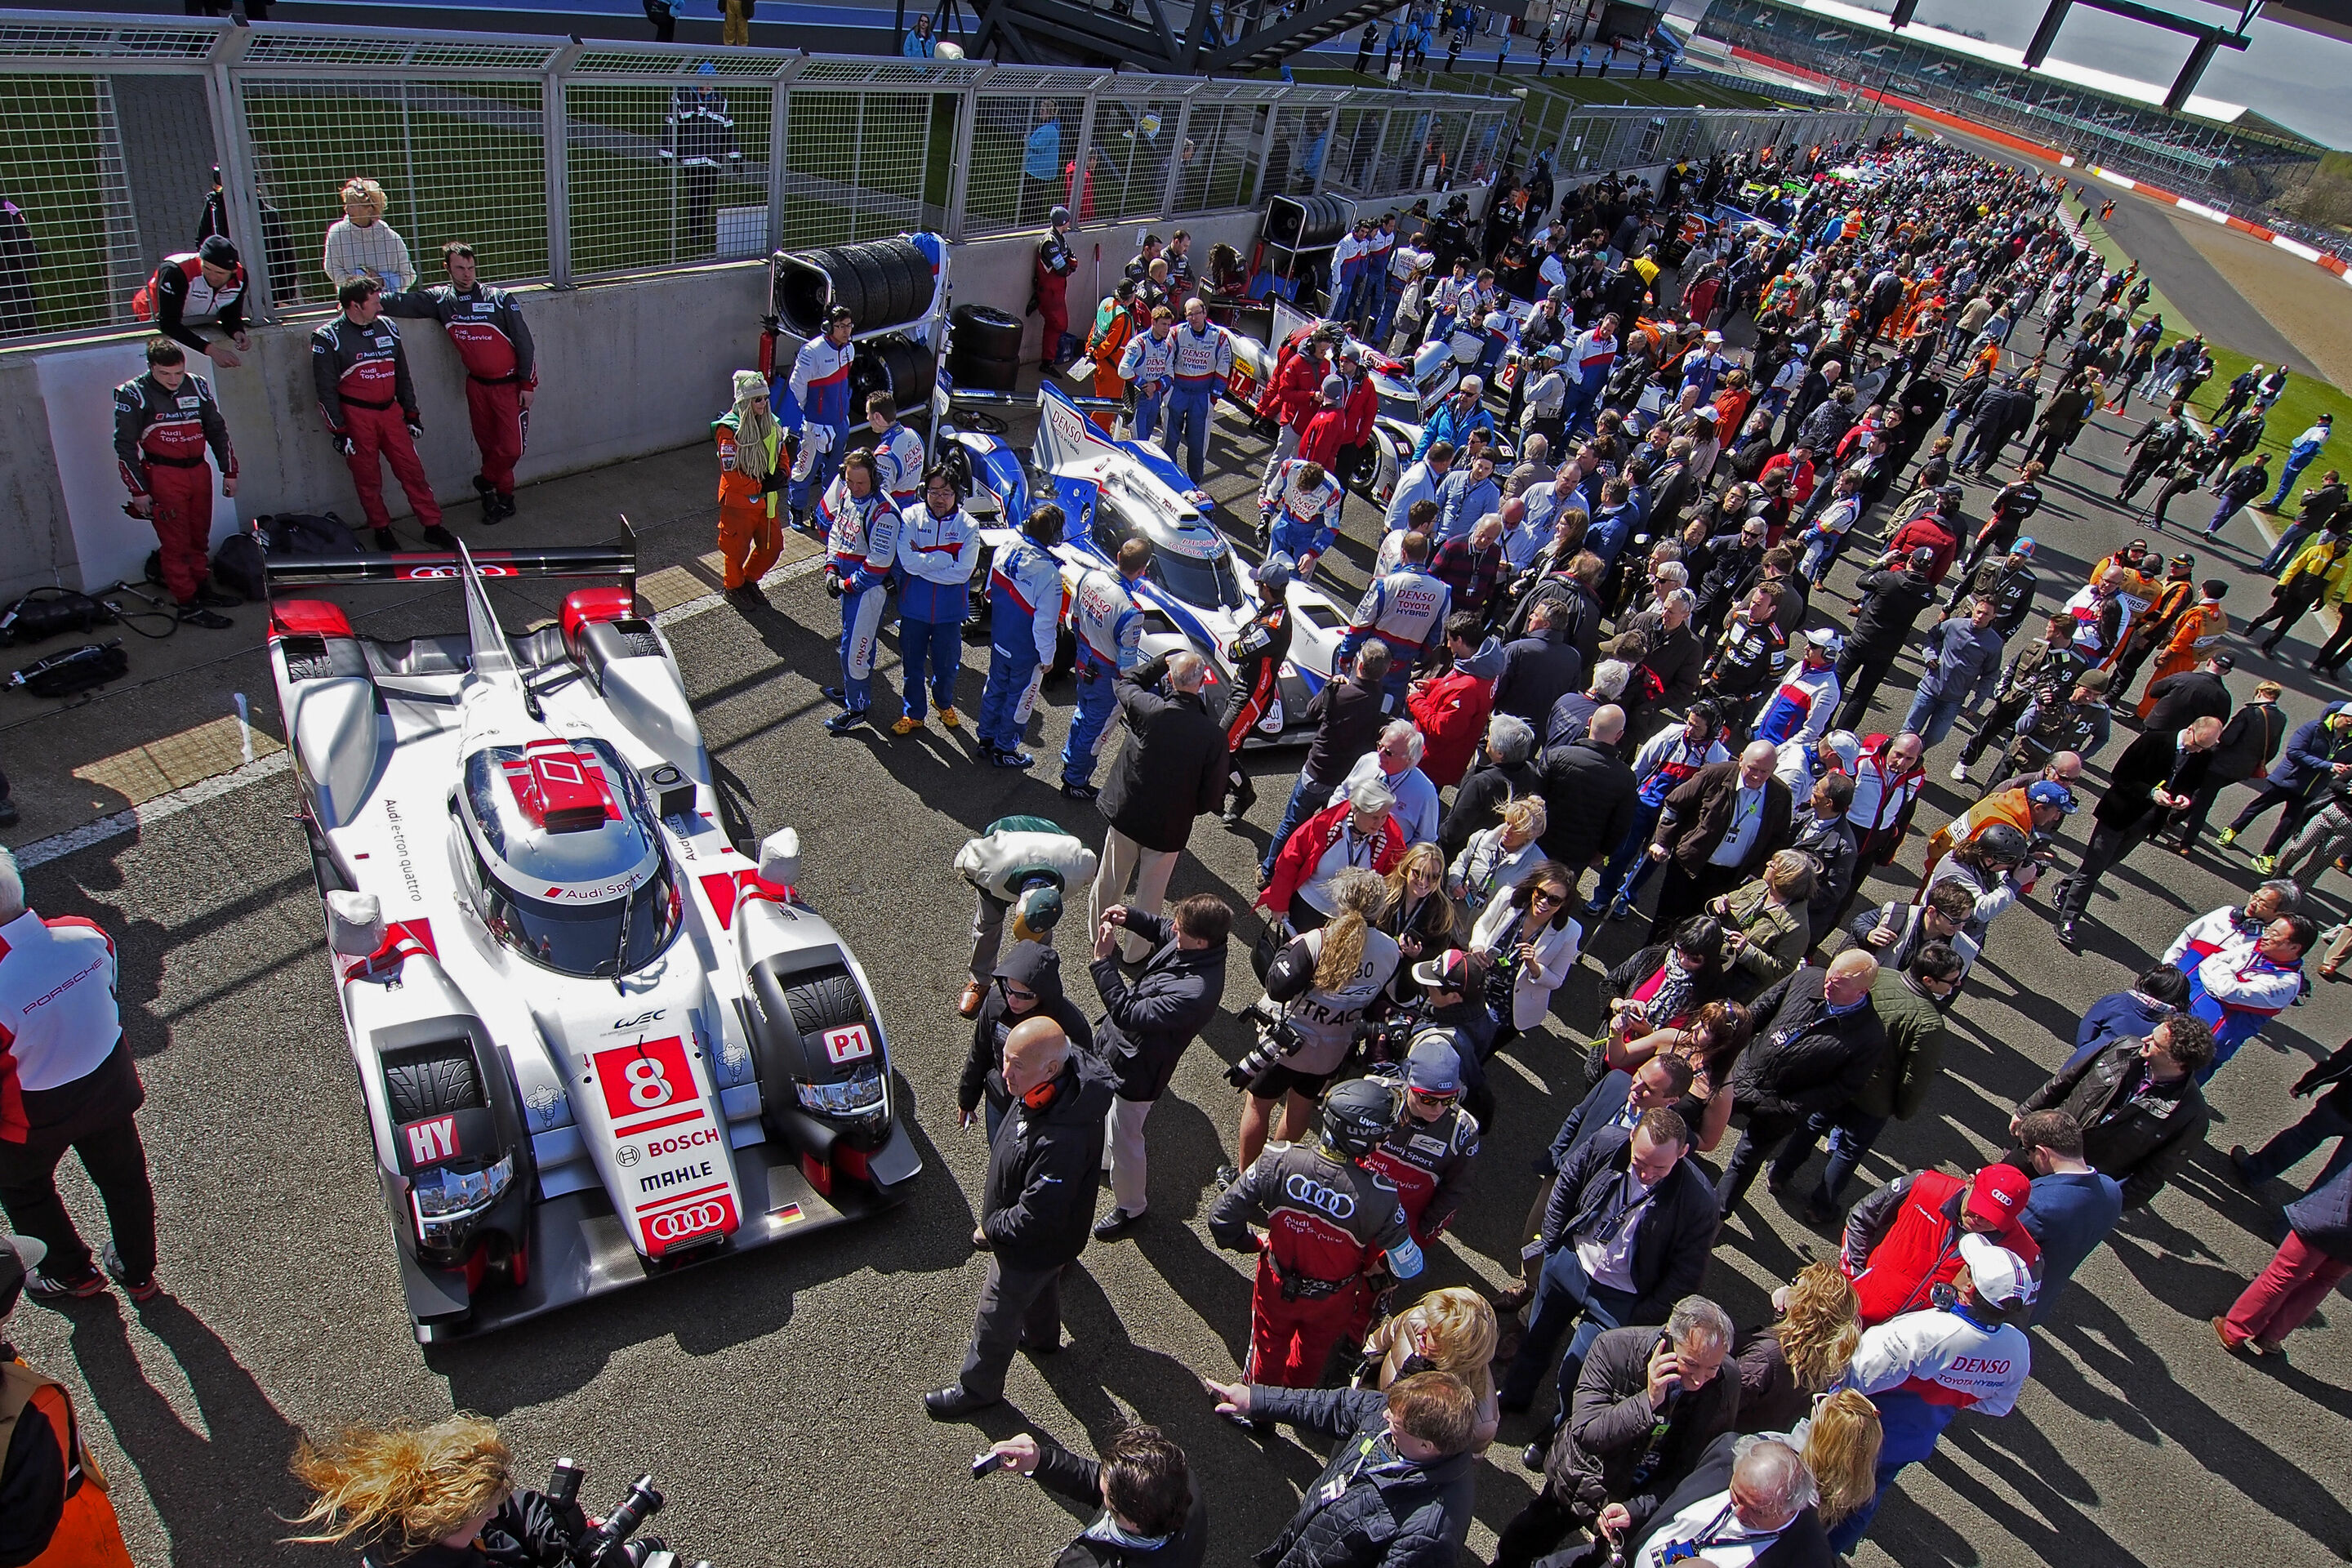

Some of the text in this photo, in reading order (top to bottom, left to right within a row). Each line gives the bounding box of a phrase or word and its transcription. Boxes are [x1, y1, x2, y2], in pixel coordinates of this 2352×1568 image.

[1276, 307, 1288, 318] Audi
[1182, 348, 1210, 359] DENSO
[1052, 409, 1082, 444] DENSO
[1168, 541, 1204, 557] TOYOTA
[1183, 537, 1219, 548] DENSO
[1083, 585, 1111, 613] DENSO
[1397, 590, 1436, 602] DENSO
[2007, 586, 2023, 599] 26
[1081, 596, 1103, 622] TOYOTA
[1396, 608, 1429, 618] HYBRID
[1398, 600, 1431, 611] TOYOTA
[856, 637, 869, 666] DENSO
[1024, 683, 1037, 710] DENSO
[2076, 722, 2092, 734] 25
[384, 800, 422, 902] Audi e-tron quattro
[678, 834, 697, 862] Audi
[565, 872, 644, 899] Audi Sport
[22, 957, 104, 1015] PORSCHE
[613, 1008, 666, 1030] WEC
[1304, 998, 1362, 1027] TRAC
[833, 1027, 866, 1057] P1
[623, 1057, 674, 1108] 8
[408, 1118, 454, 1165] HY
[1346, 1124, 1396, 1136] uvex
[648, 1128, 719, 1157] BOSCH
[1383, 1140, 1434, 1169] Audi Sport
[1365, 1154, 1388, 1170] Audi
[640, 1160, 713, 1193] MAHLE
[1284, 1214, 1310, 1227] Audi
[1285, 1221, 1305, 1234] Top
[1949, 1356, 2011, 1375] DENSO
[1939, 1373, 2005, 1388] TOYOTA HYBRI
